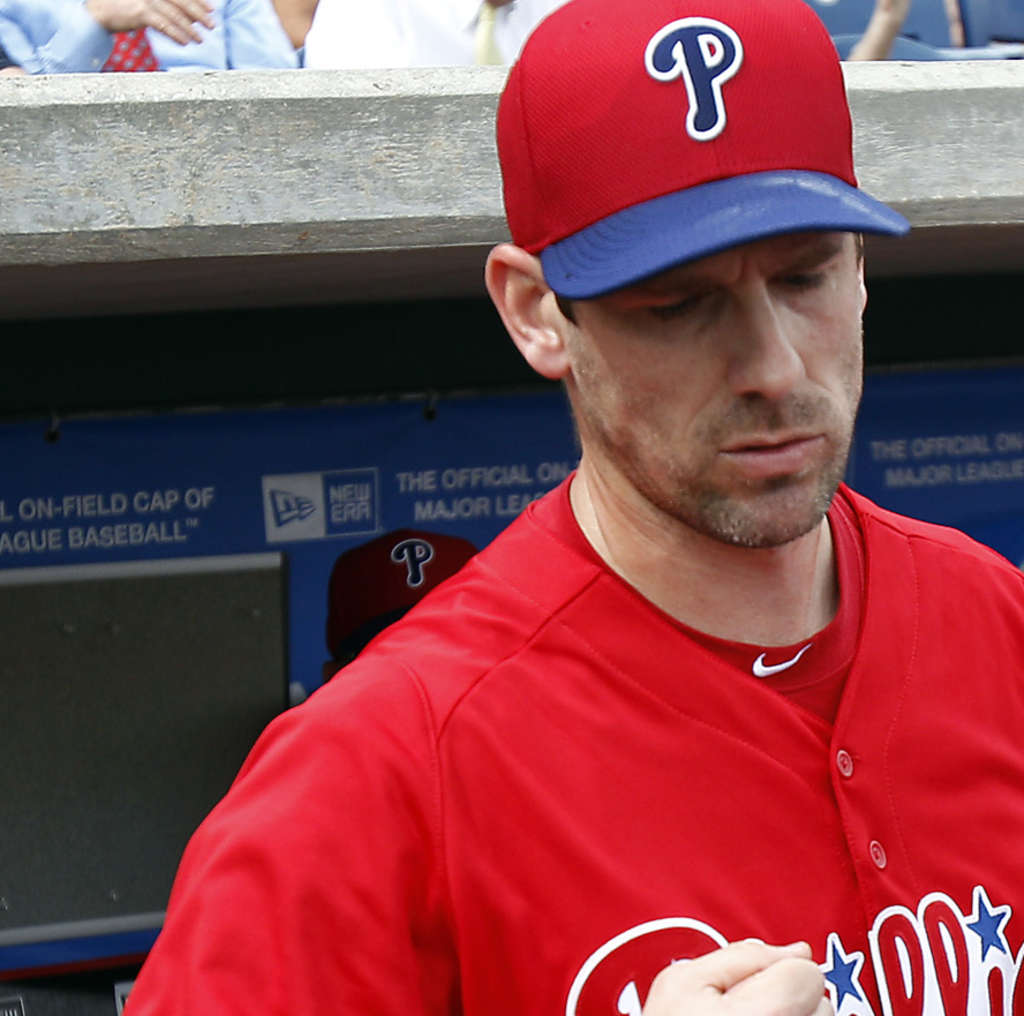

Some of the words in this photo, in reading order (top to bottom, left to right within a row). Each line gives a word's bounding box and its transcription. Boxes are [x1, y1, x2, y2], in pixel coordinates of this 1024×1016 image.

[644, 16, 744, 141] P
[329, 482, 371, 500] NEW
[396, 469, 436, 494] THE
[441, 465, 533, 491] OFFICIAL
[19, 492, 127, 521] ON-FIELD
[133, 489, 179, 513] CAP
[185, 486, 215, 509] OF
[331, 502, 371, 522] ERA
[414, 497, 492, 522] MAJOR
[391, 538, 434, 587] P
